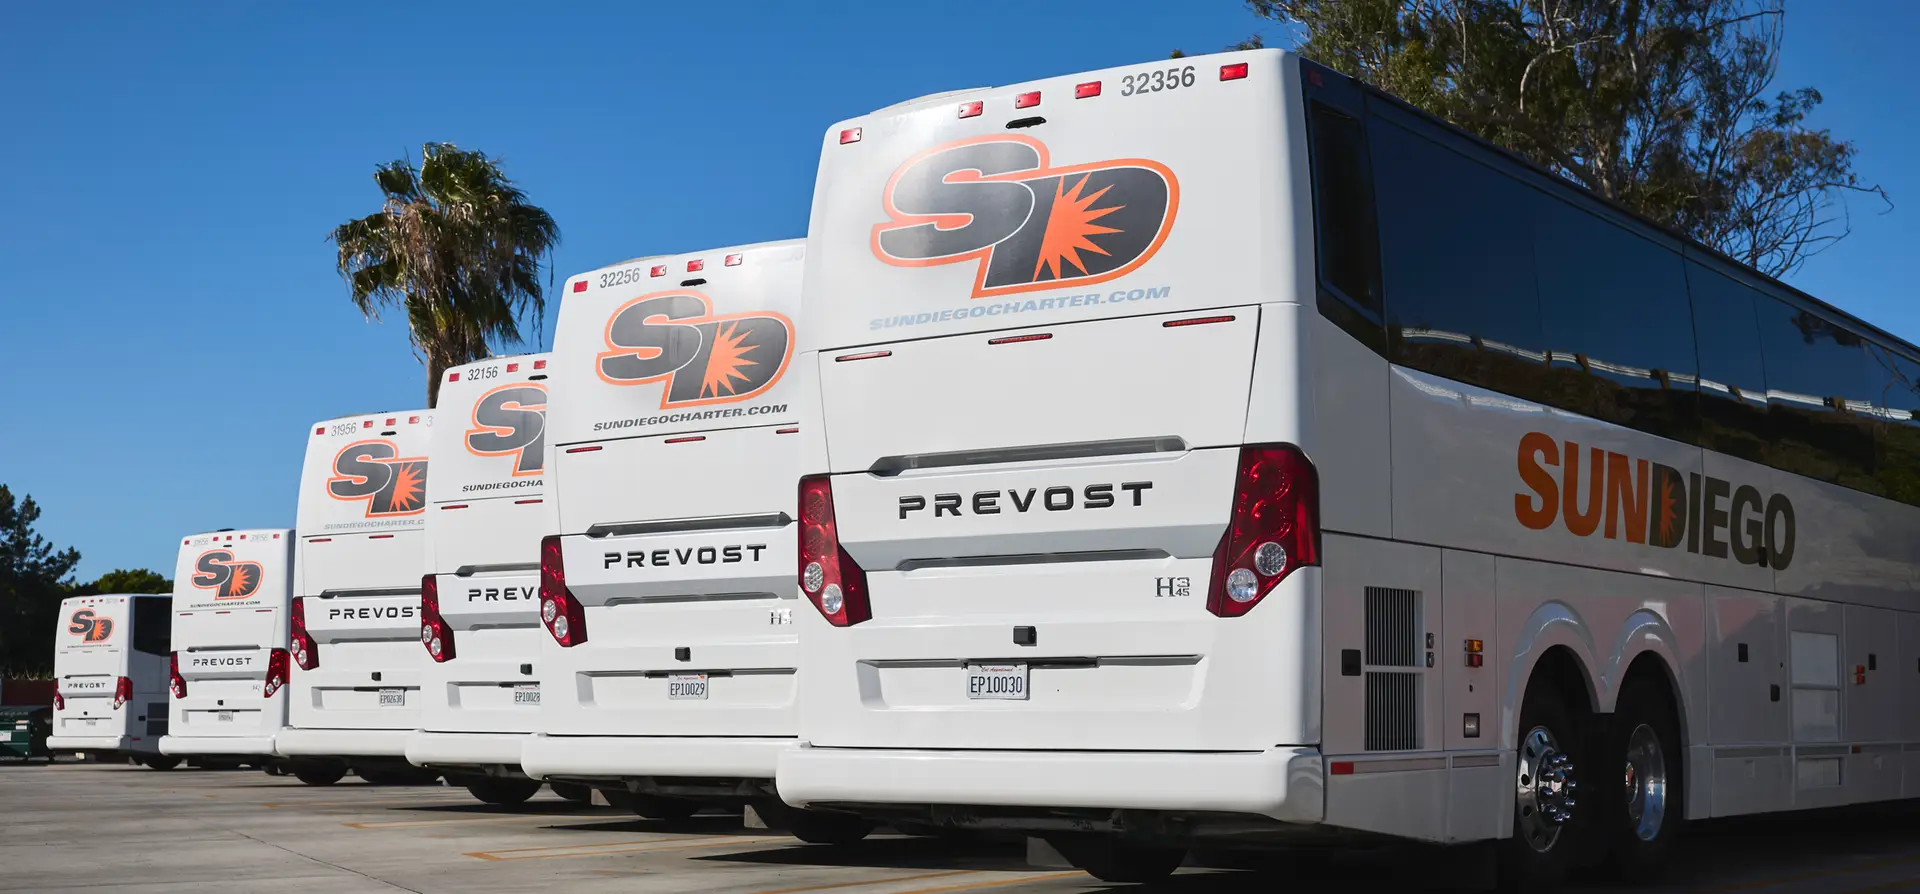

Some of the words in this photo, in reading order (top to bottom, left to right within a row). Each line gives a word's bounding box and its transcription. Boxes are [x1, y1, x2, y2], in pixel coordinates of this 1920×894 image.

[1121, 65, 1196, 97] 32356
[870, 133, 1181, 299] SD
[600, 268, 641, 289] 32256
[869, 286, 1171, 331] SUNDIEGOCHARTER.COM
[595, 289, 796, 410] SD
[467, 366, 499, 381] 32156
[331, 422, 357, 436] 31956
[593, 404, 788, 432] SUNDIEGOCHARTER.COM
[899, 481, 1153, 520] PREVOST
[1514, 431, 1796, 571] SUNDIEGO
[604, 543, 767, 569] PREVOST
[191, 549, 264, 601] SD
[468, 586, 541, 601] PREV
[68, 608, 114, 643] SD
[193, 657, 252, 666] PREVOST
[670, 682, 705, 696] EP10029
[970, 676, 1023, 693] EP10030
